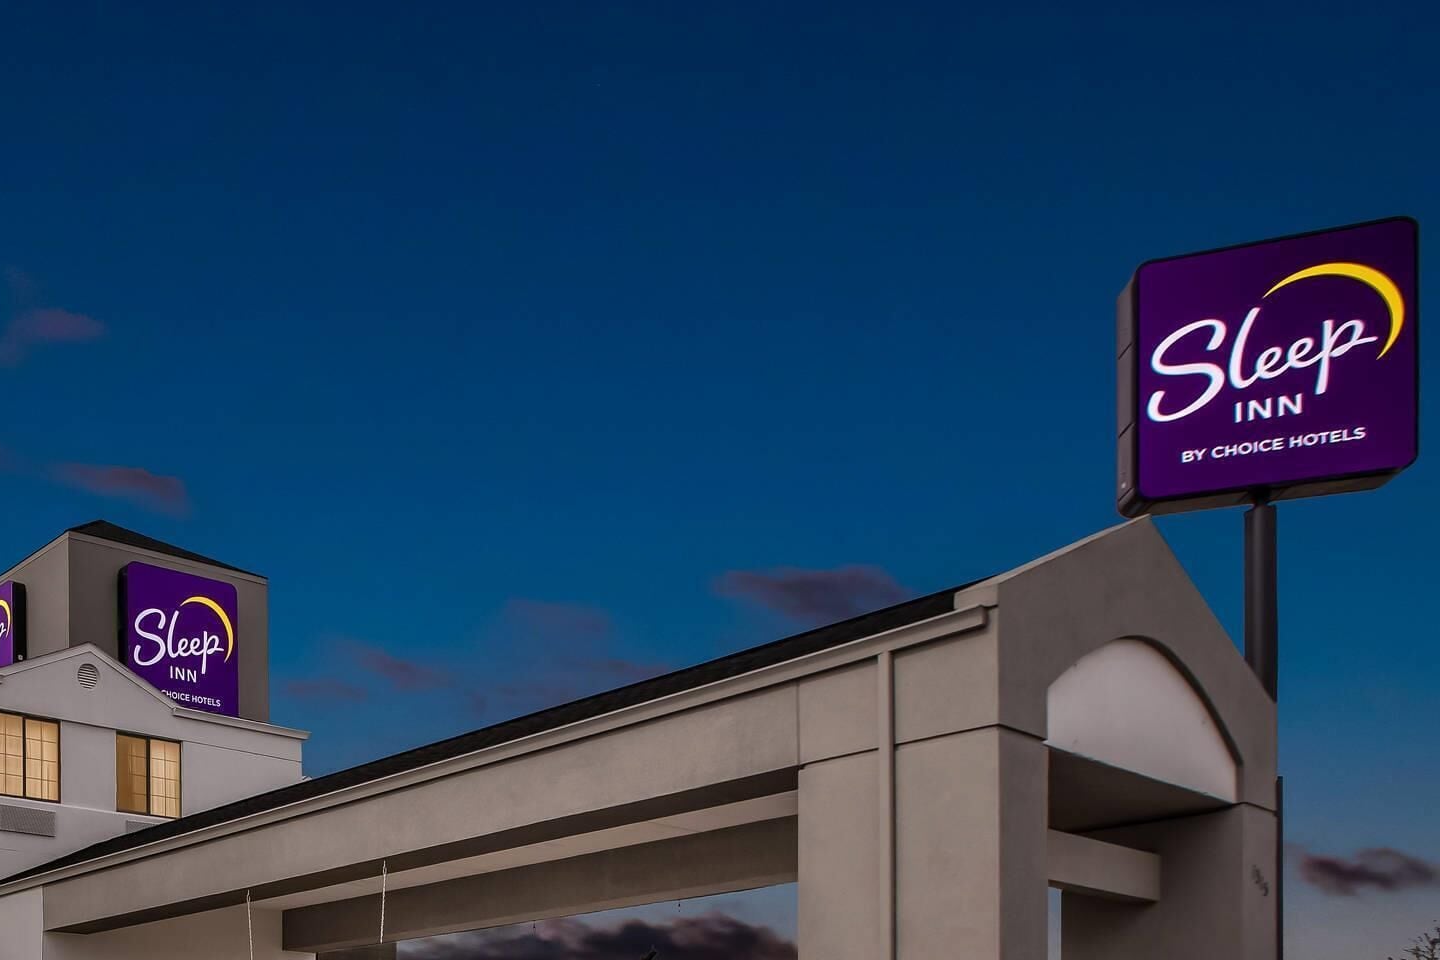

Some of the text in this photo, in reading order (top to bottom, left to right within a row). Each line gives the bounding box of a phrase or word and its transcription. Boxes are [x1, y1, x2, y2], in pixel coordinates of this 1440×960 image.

[1146, 306, 1379, 423] Sleep
[1234, 393, 1303, 423] INN
[1181, 427, 1367, 463] BY CHOICE HOTELS
[133, 608, 225, 675] Sleep
[170, 665, 197, 683] INN
[161, 689, 221, 707] HOICE HOTELS
